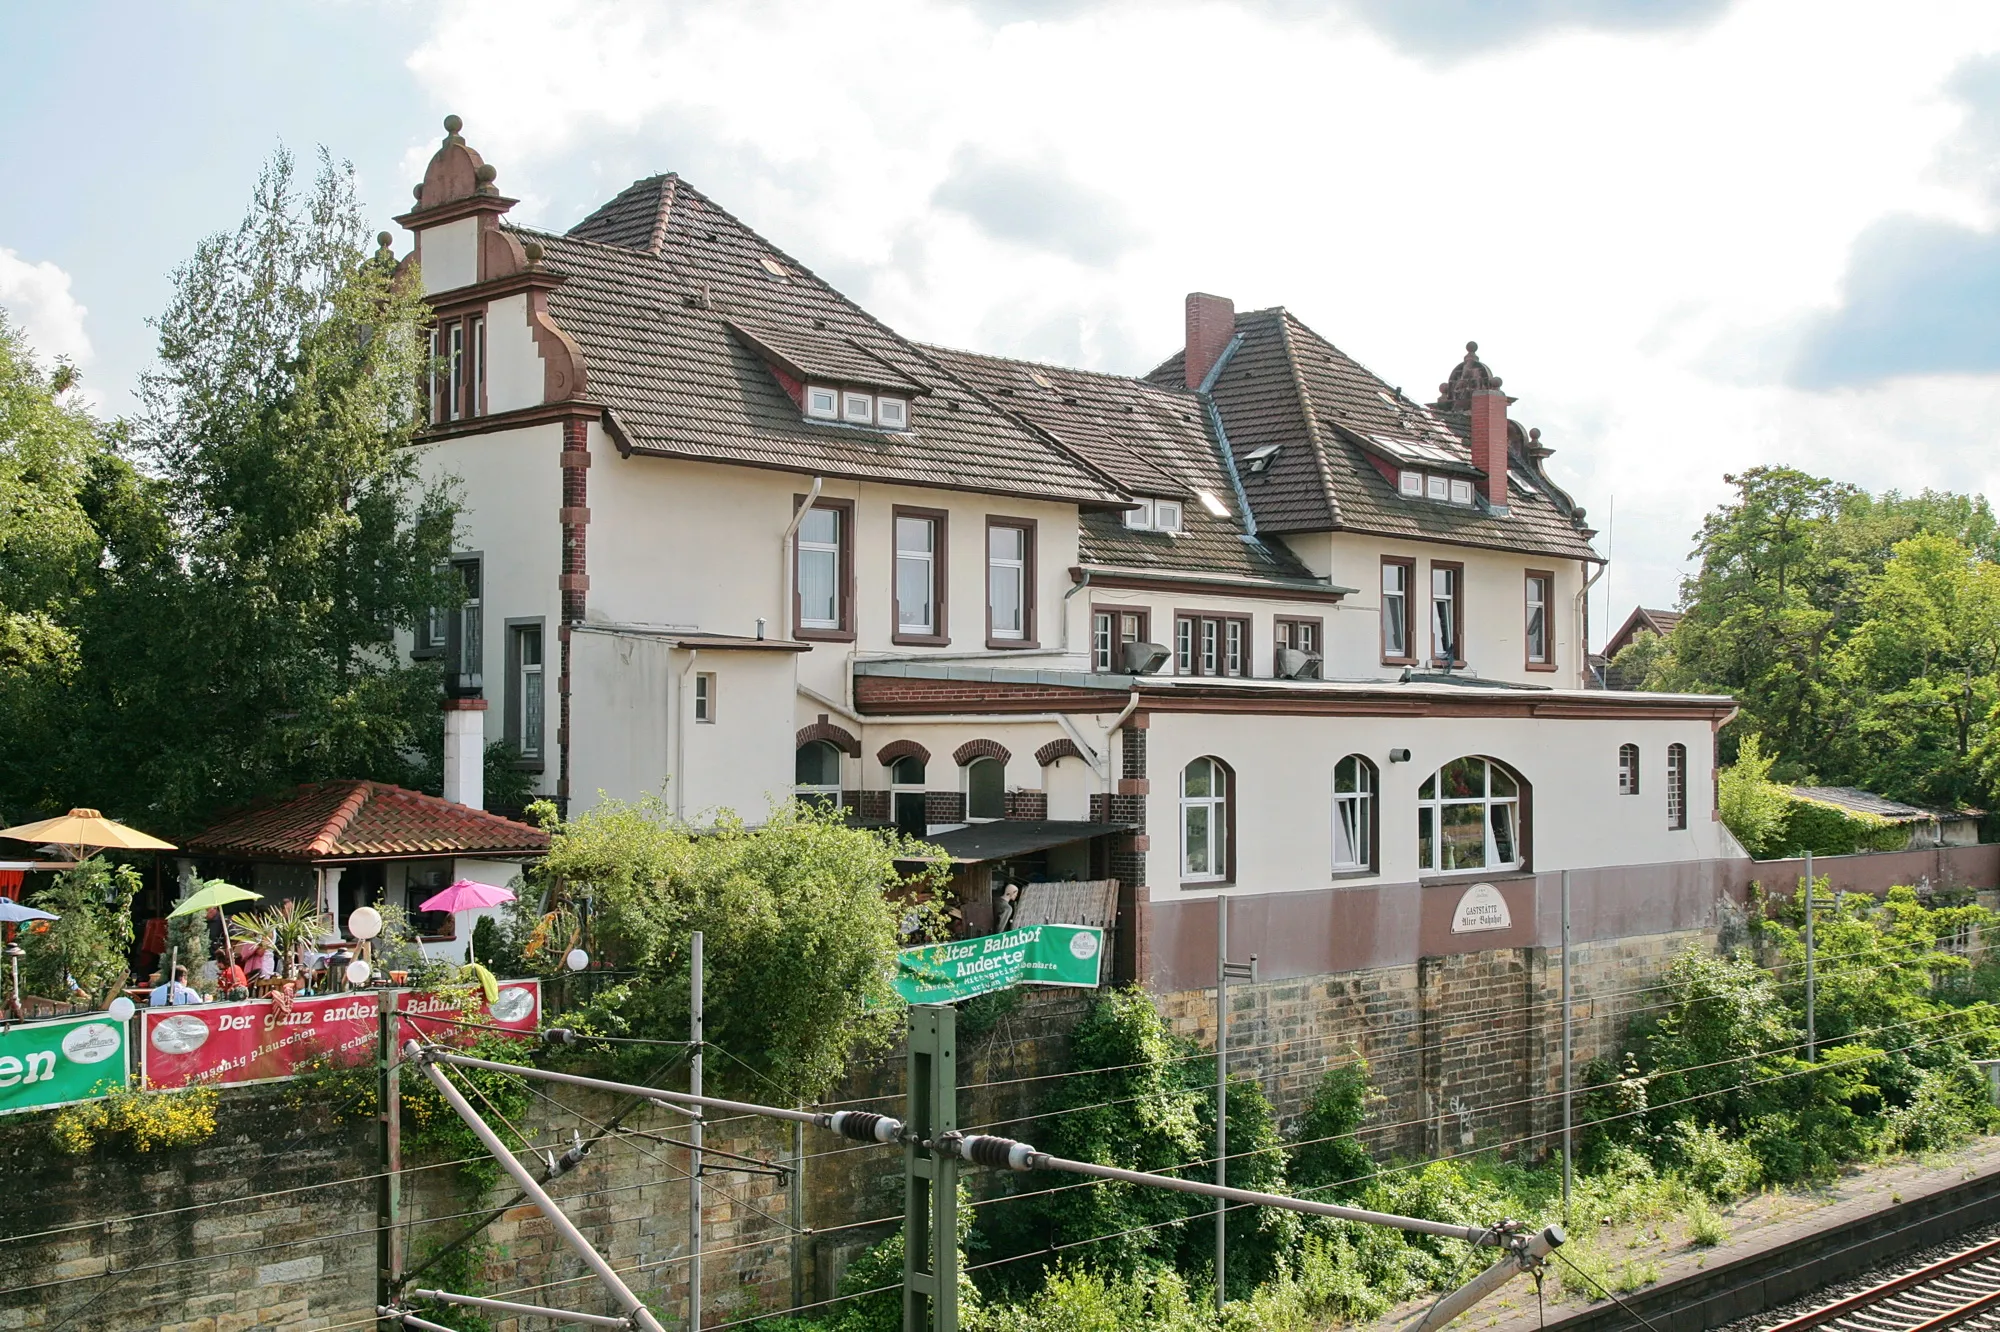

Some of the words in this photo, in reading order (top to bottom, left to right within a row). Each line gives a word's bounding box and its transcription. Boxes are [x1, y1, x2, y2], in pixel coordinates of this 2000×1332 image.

[1462, 917, 1476, 926] Alter
[1480, 914, 1502, 926] Bahnhof
[1466, 904, 1497, 915] GASTSTÄTTE
[983, 927, 1042, 954] Bahnhof
[956, 949, 1025, 977] Anderte
[218, 1014, 255, 1032] Der
[406, 991, 483, 1014] Bahnhf
[250, 1027, 316, 1062] plauschen
